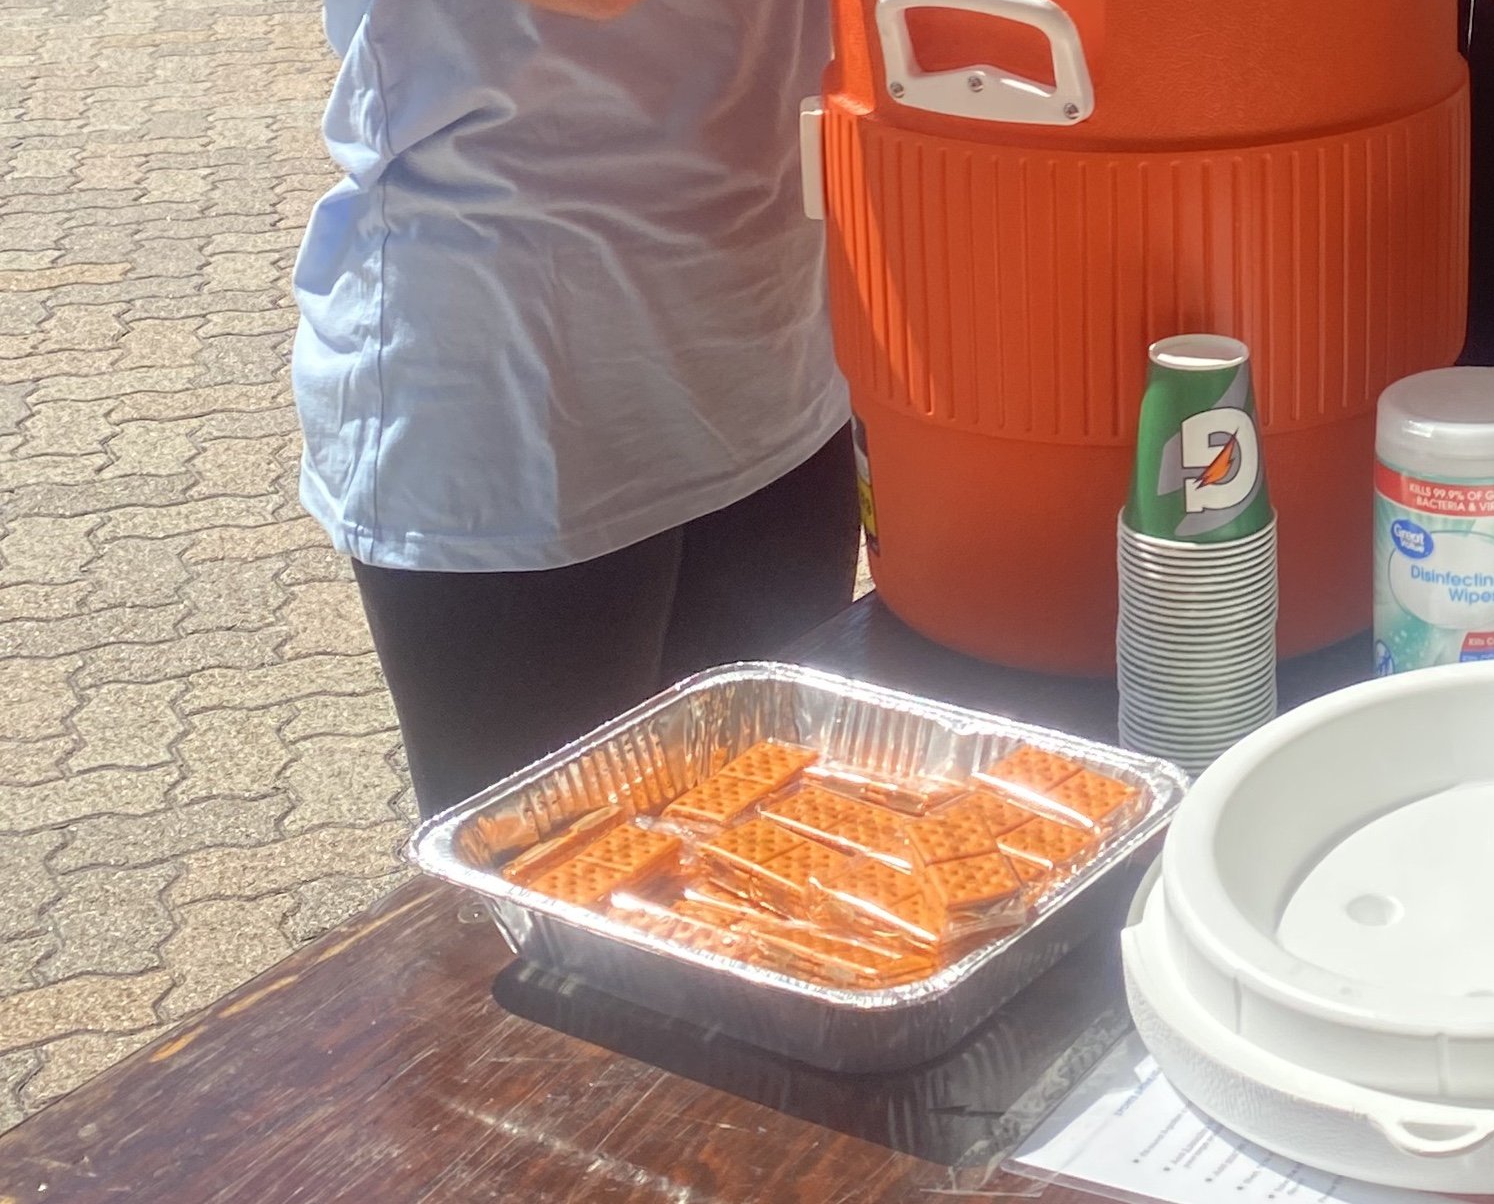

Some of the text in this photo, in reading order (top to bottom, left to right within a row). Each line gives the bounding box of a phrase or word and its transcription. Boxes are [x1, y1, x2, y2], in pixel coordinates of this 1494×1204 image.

[1409, 483, 1431, 497] KILLS
[1433, 487, 1465, 501] 99.9%
[1467, 490, 1482, 501] OF
[1416, 496, 1466, 511] BACTERIA
[1468, 502, 1476, 511] &
